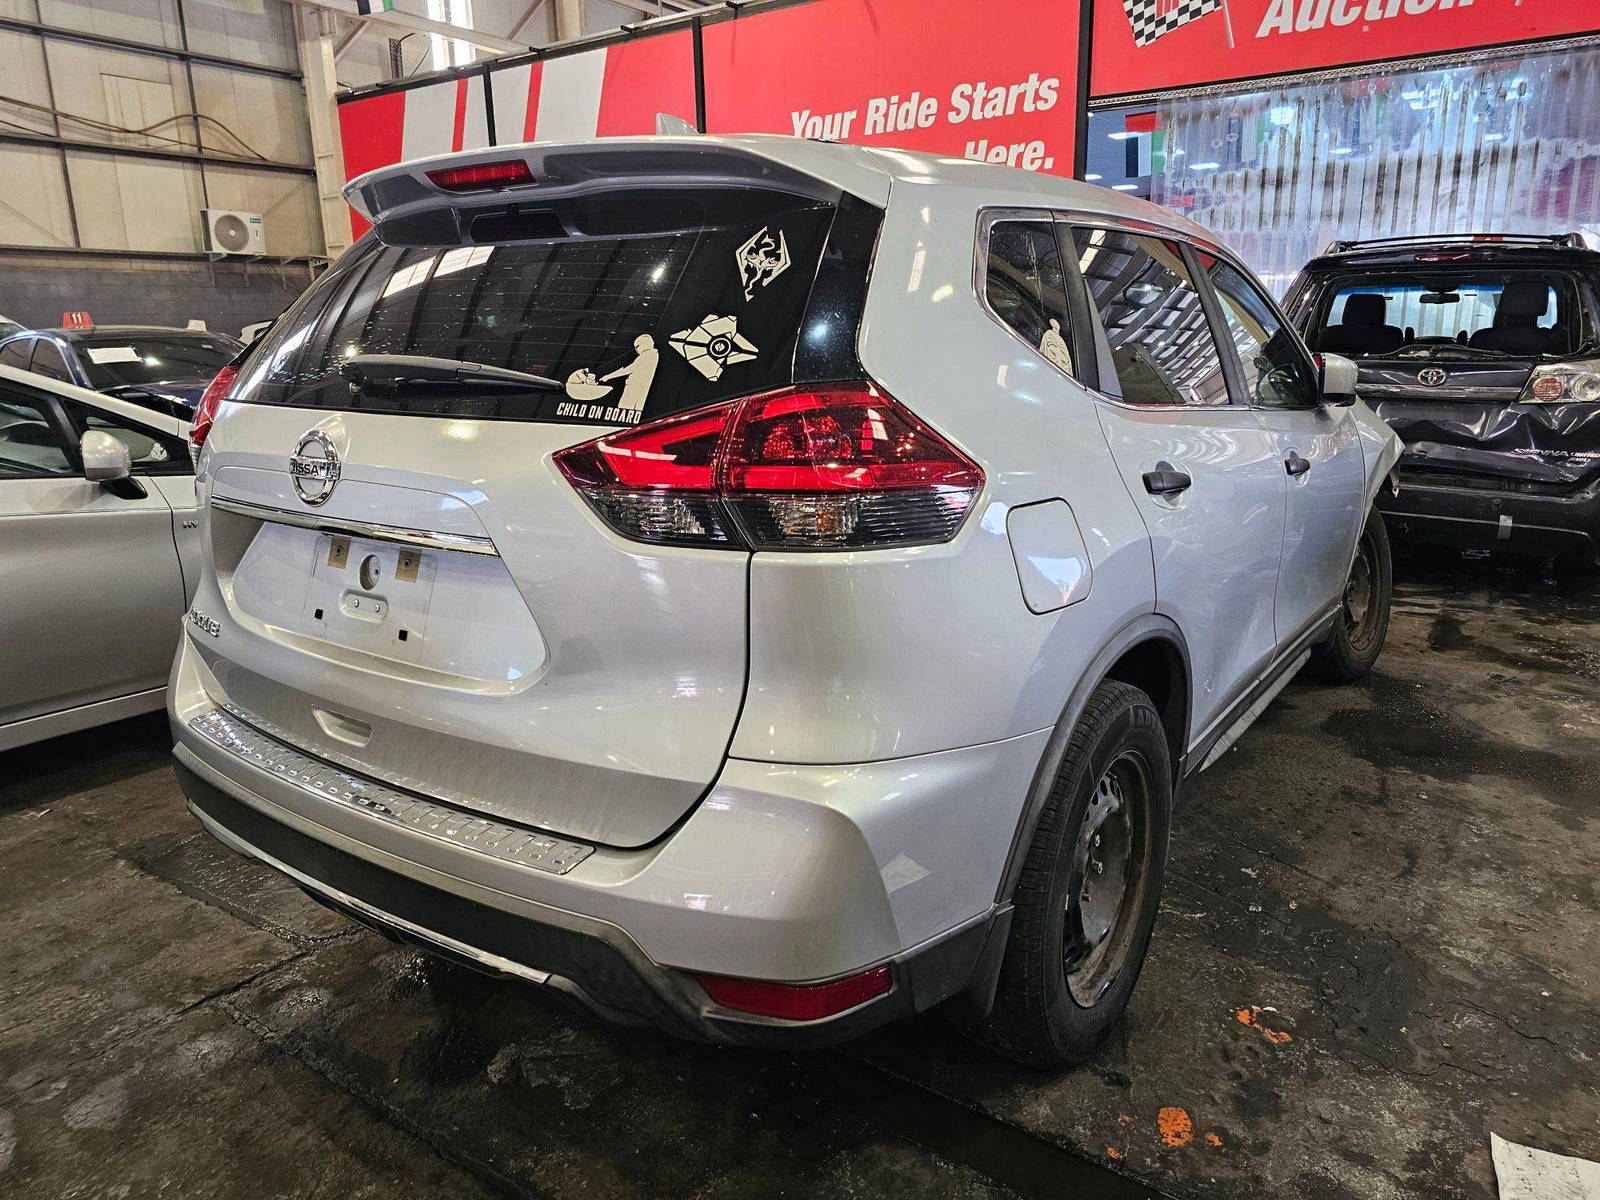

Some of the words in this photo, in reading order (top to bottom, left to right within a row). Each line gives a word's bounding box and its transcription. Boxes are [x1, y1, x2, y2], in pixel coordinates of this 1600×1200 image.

[791, 109, 857, 140] Your
[864, 91, 938, 136] Ride
[947, 72, 1060, 124] Starts
[964, 140, 1055, 171] Here.
[588, 405, 604, 419] ON
[604, 406, 642, 424] BOARD
